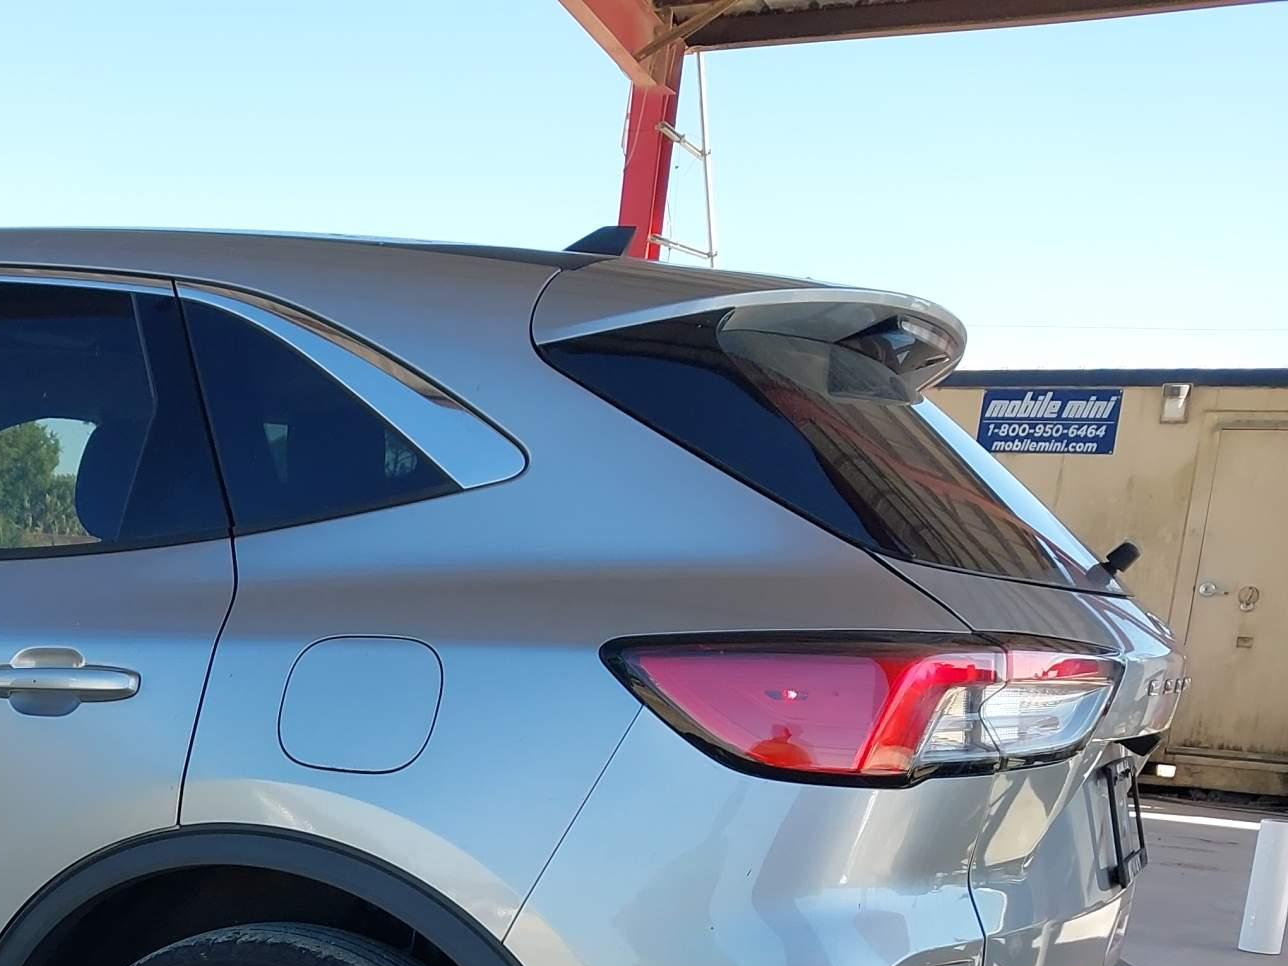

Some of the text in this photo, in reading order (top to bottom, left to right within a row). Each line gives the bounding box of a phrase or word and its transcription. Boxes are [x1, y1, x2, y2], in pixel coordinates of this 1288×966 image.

[985, 392, 1117, 419] mobile mini
[987, 424, 1106, 438] 1-800-950-6464
[991, 439, 1097, 453] mobilemini.com
